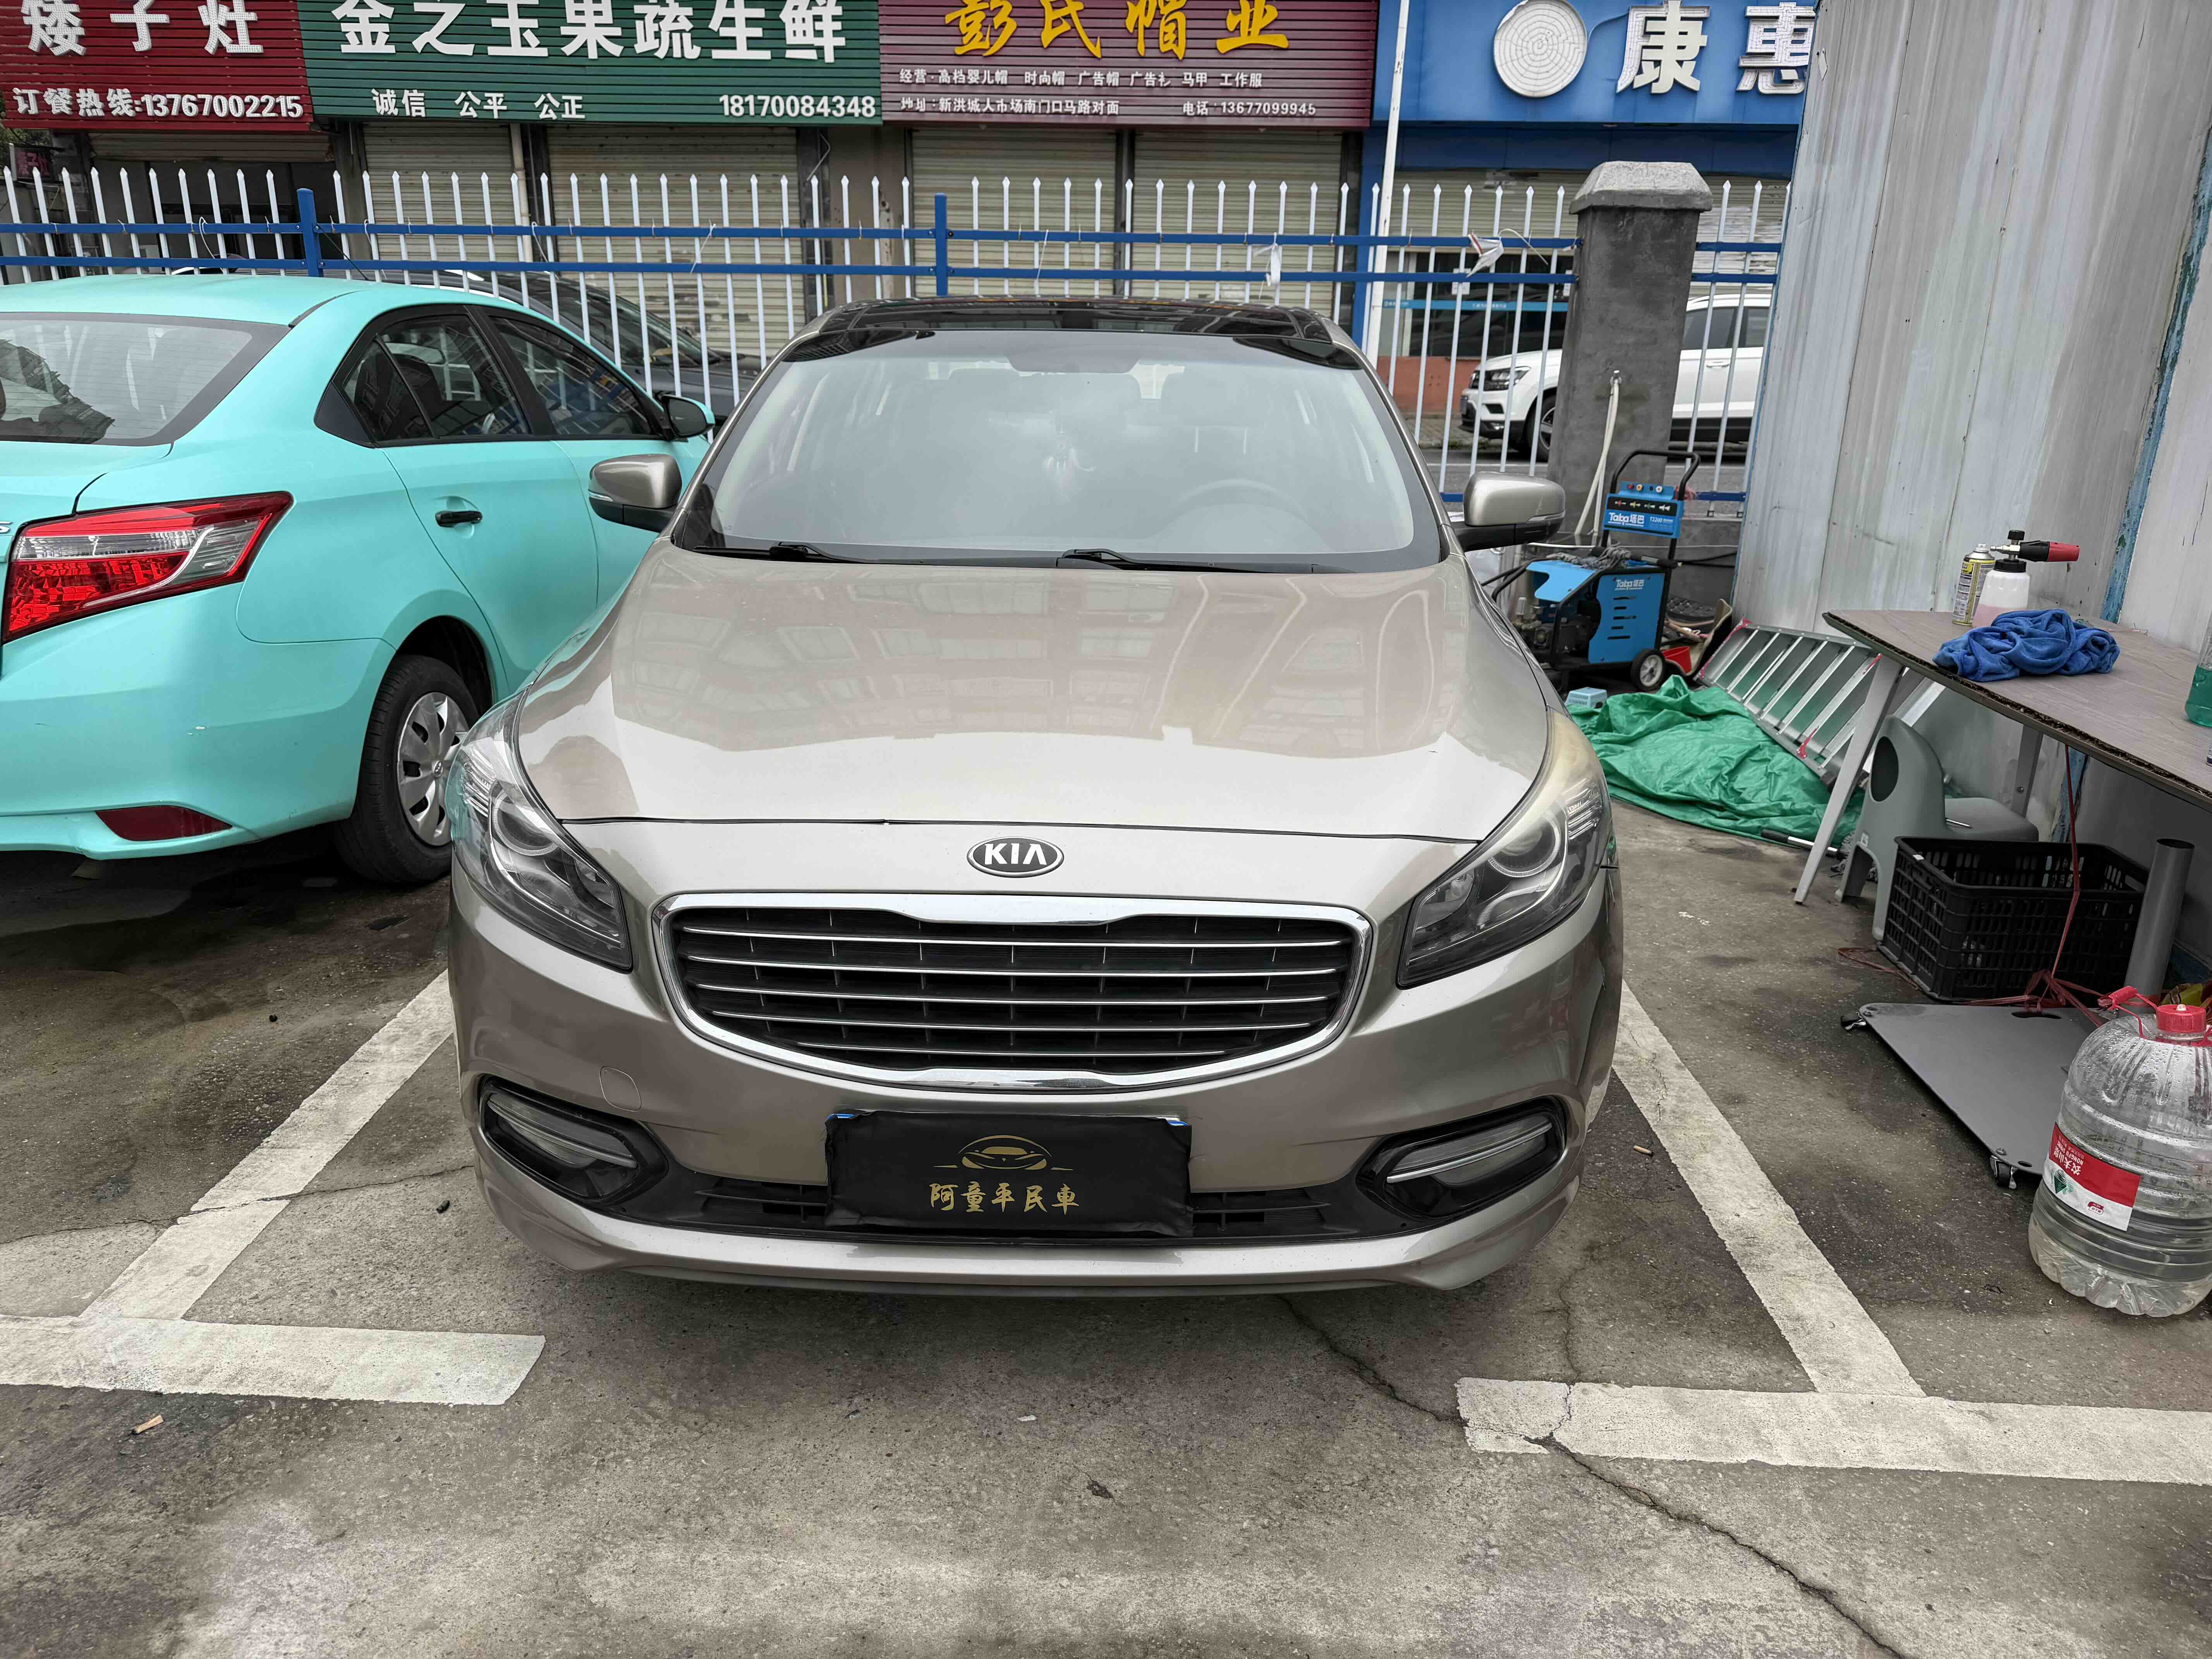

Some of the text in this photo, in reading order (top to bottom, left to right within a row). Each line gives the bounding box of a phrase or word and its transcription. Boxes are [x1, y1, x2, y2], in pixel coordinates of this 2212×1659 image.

[21, 0, 264, 55] 矮子灶
[331, 0, 846, 63] 金之玉果蔬生鲜
[945, 0, 1290, 60] 彭氏帽业
[1616, 0, 1816, 94] 康惠
[1078, 70, 1120, 86] 广告帽
[1182, 72, 1207, 87] 马甲
[1219, 72, 1262, 88] 工作服
[371, 89, 586, 120] 诚信 公平 公正
[719, 94, 876, 118] 18170084348
[984, 843, 1047, 865] KIA
